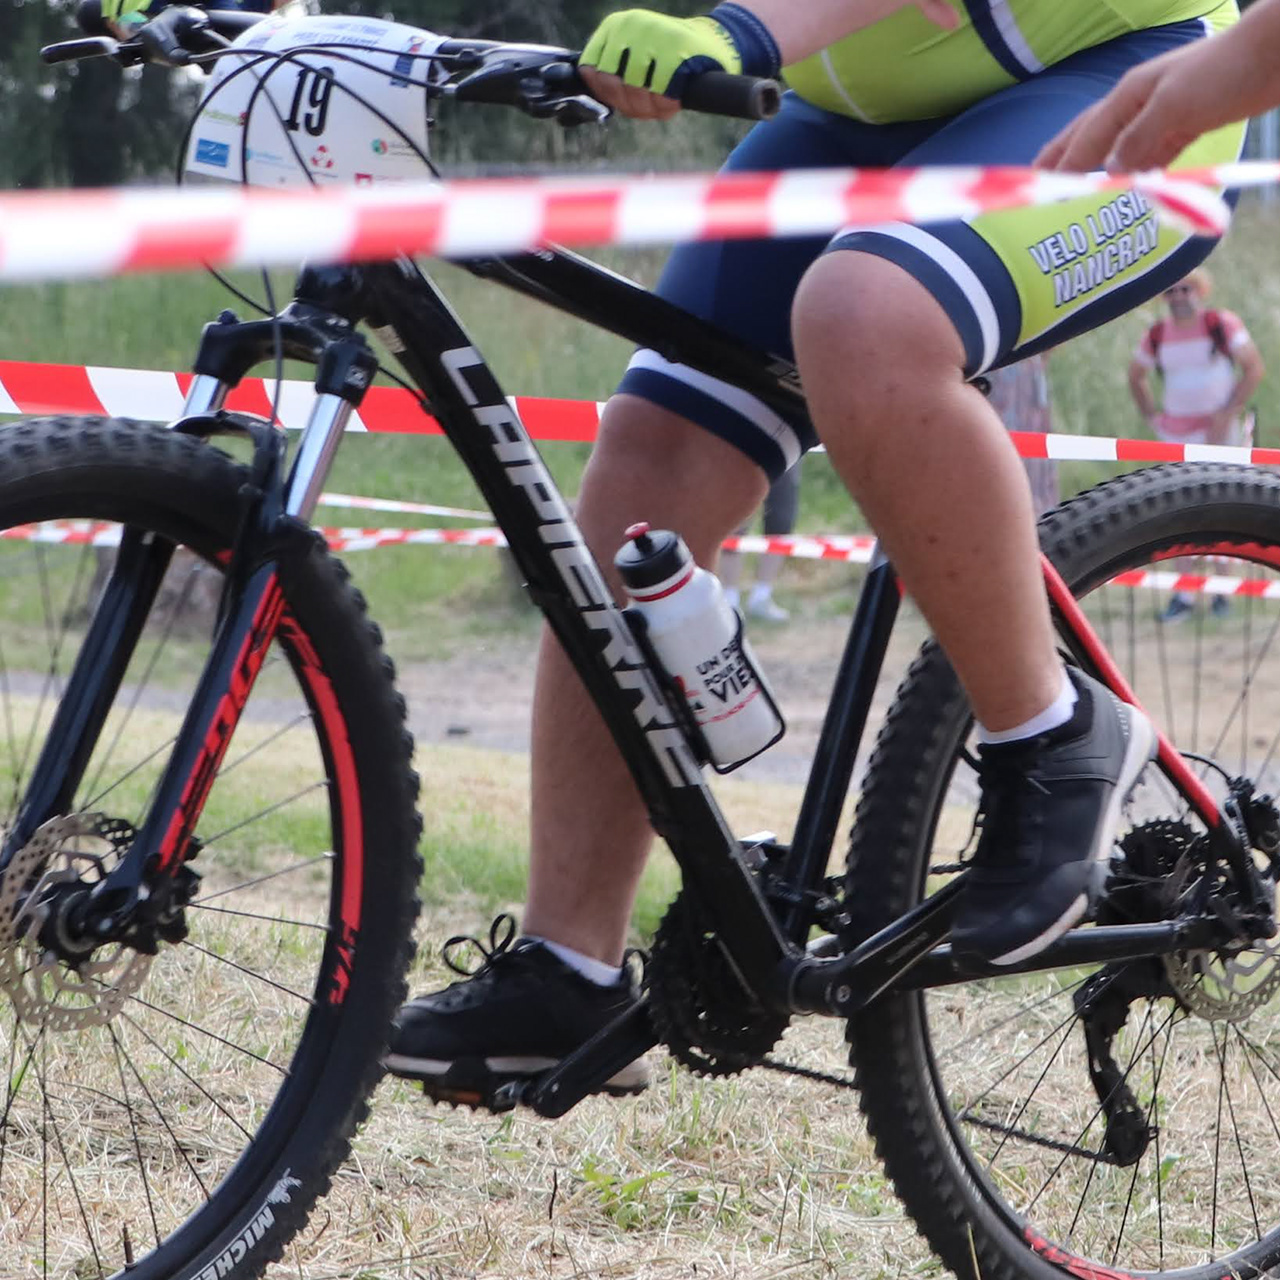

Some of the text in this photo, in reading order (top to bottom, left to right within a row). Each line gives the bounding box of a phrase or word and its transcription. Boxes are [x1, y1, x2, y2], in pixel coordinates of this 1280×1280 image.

[286, 66, 335, 136] 19
[1028, 223, 1088, 274] VELO
[1052, 212, 1161, 308] NANCRAY
[440, 346, 710, 788] LAPIERRE
[696, 656, 720, 675] UN
